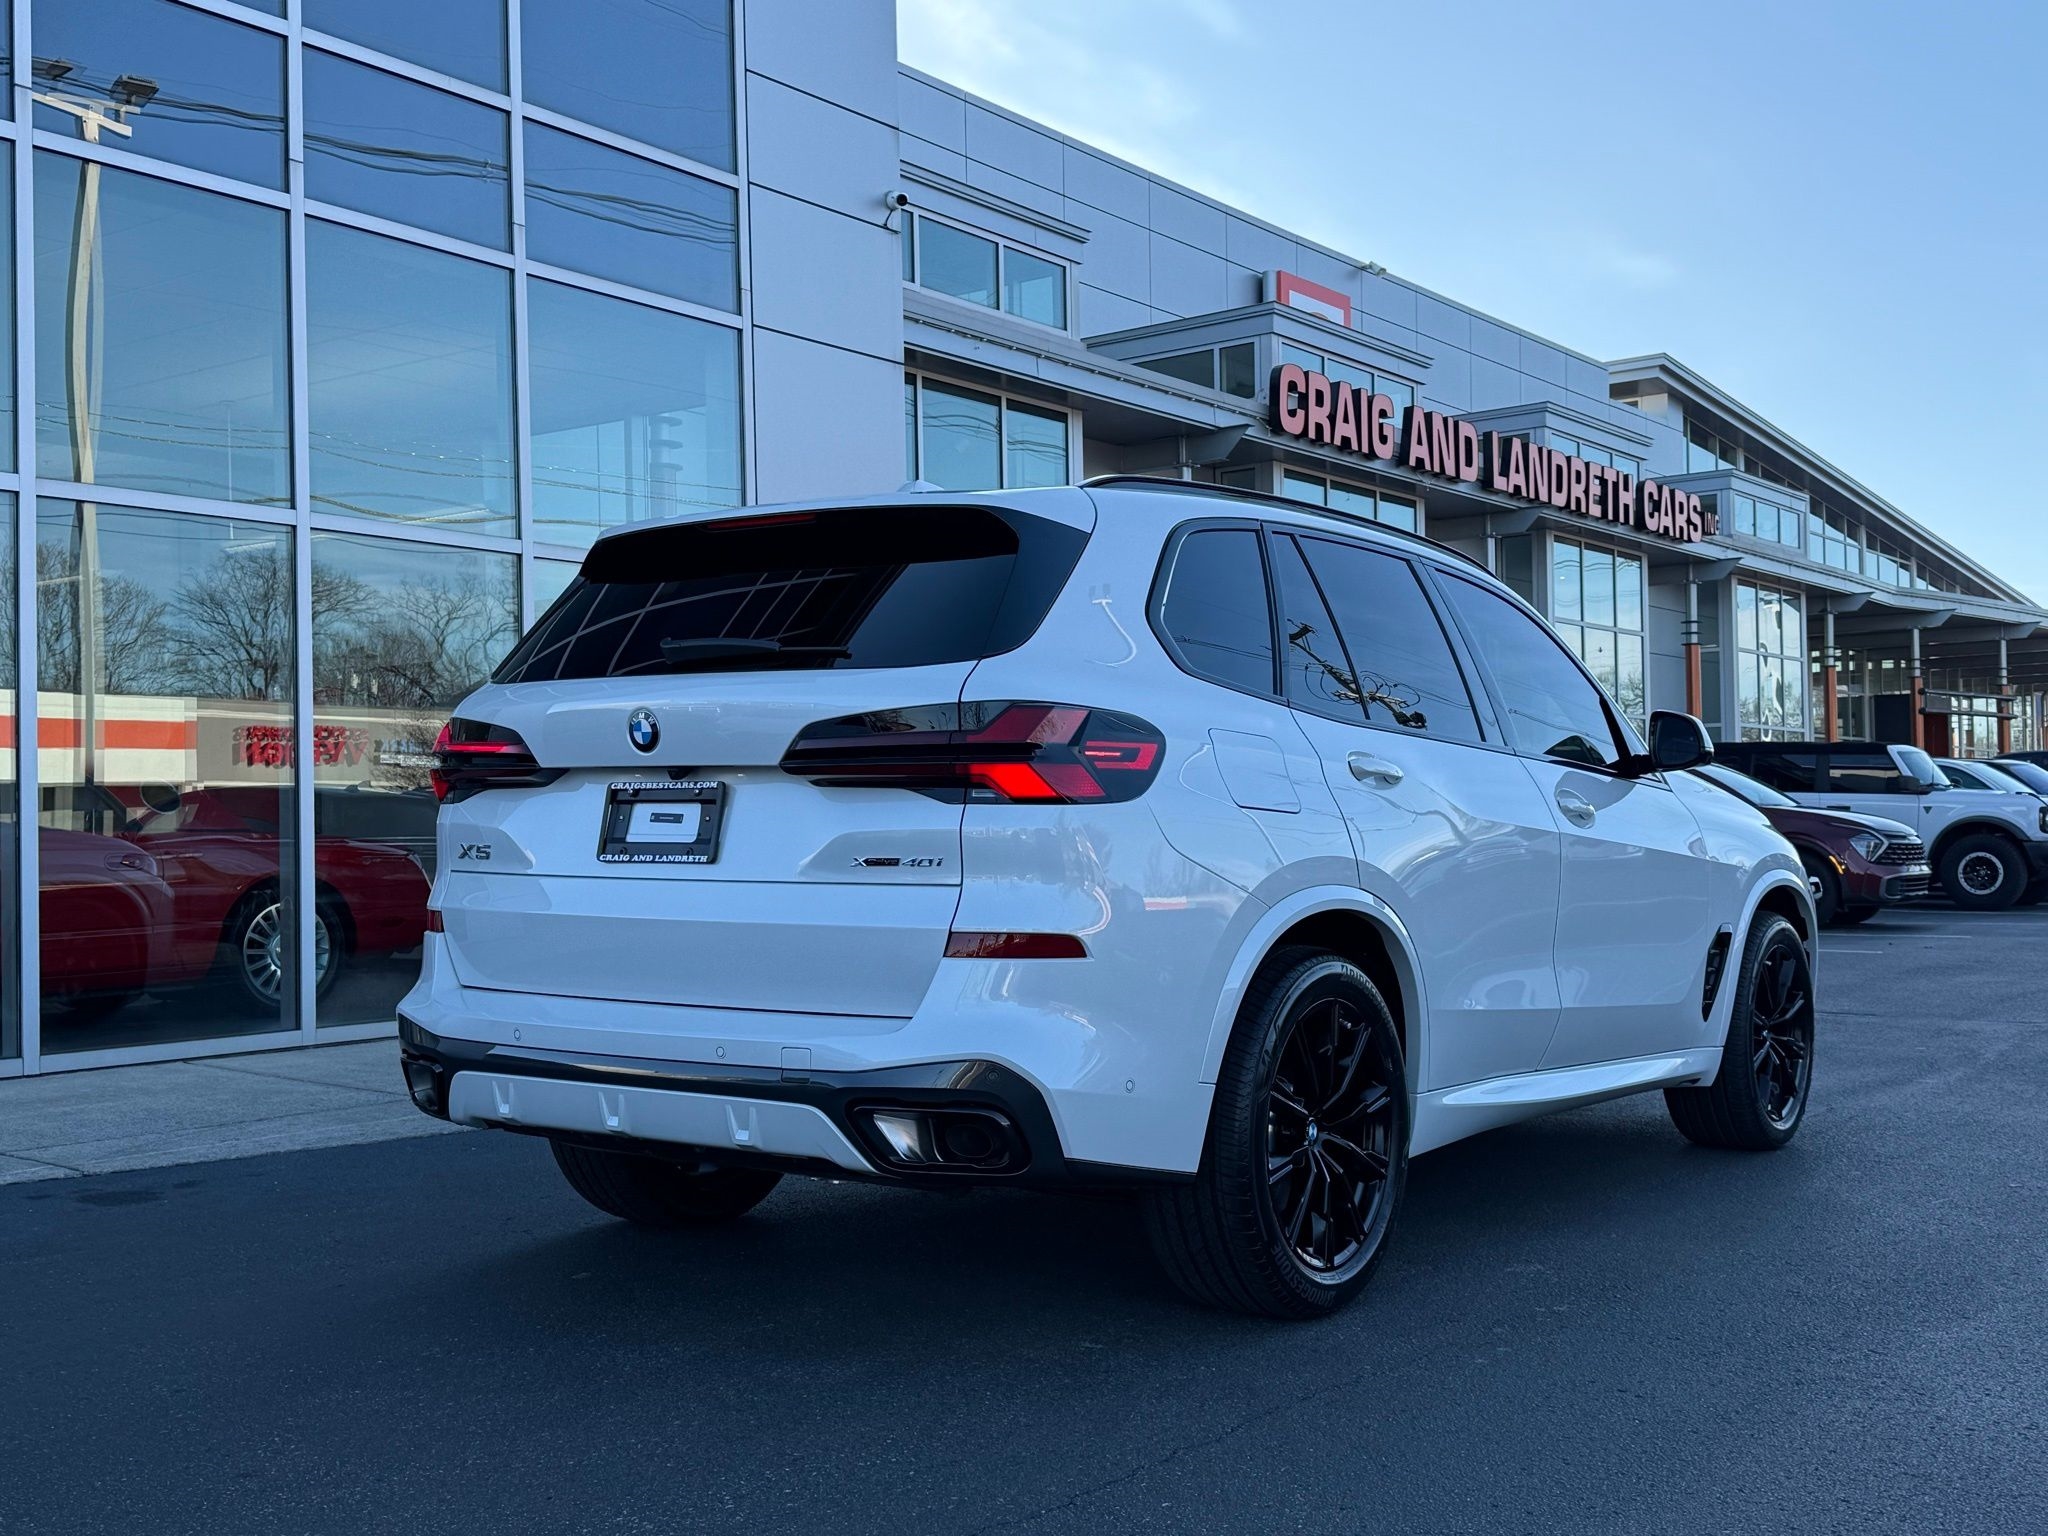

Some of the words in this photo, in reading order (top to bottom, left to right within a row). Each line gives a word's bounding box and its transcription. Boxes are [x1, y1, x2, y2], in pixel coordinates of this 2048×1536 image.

[1270, 363, 1394, 460] CRAIG
[1402, 405, 1478, 482] AND
[1484, 430, 1634, 525] LANDRETH
[1636, 479, 1702, 543] CARS
[1704, 511, 1720, 535] INC
[611, 782, 718, 790] CRAIGSBESTCARS.COM
[458, 843, 491, 860] X5
[599, 854, 630, 862] CRAIG
[632, 854, 653, 862] AND
[655, 854, 708, 863] LANDRETH
